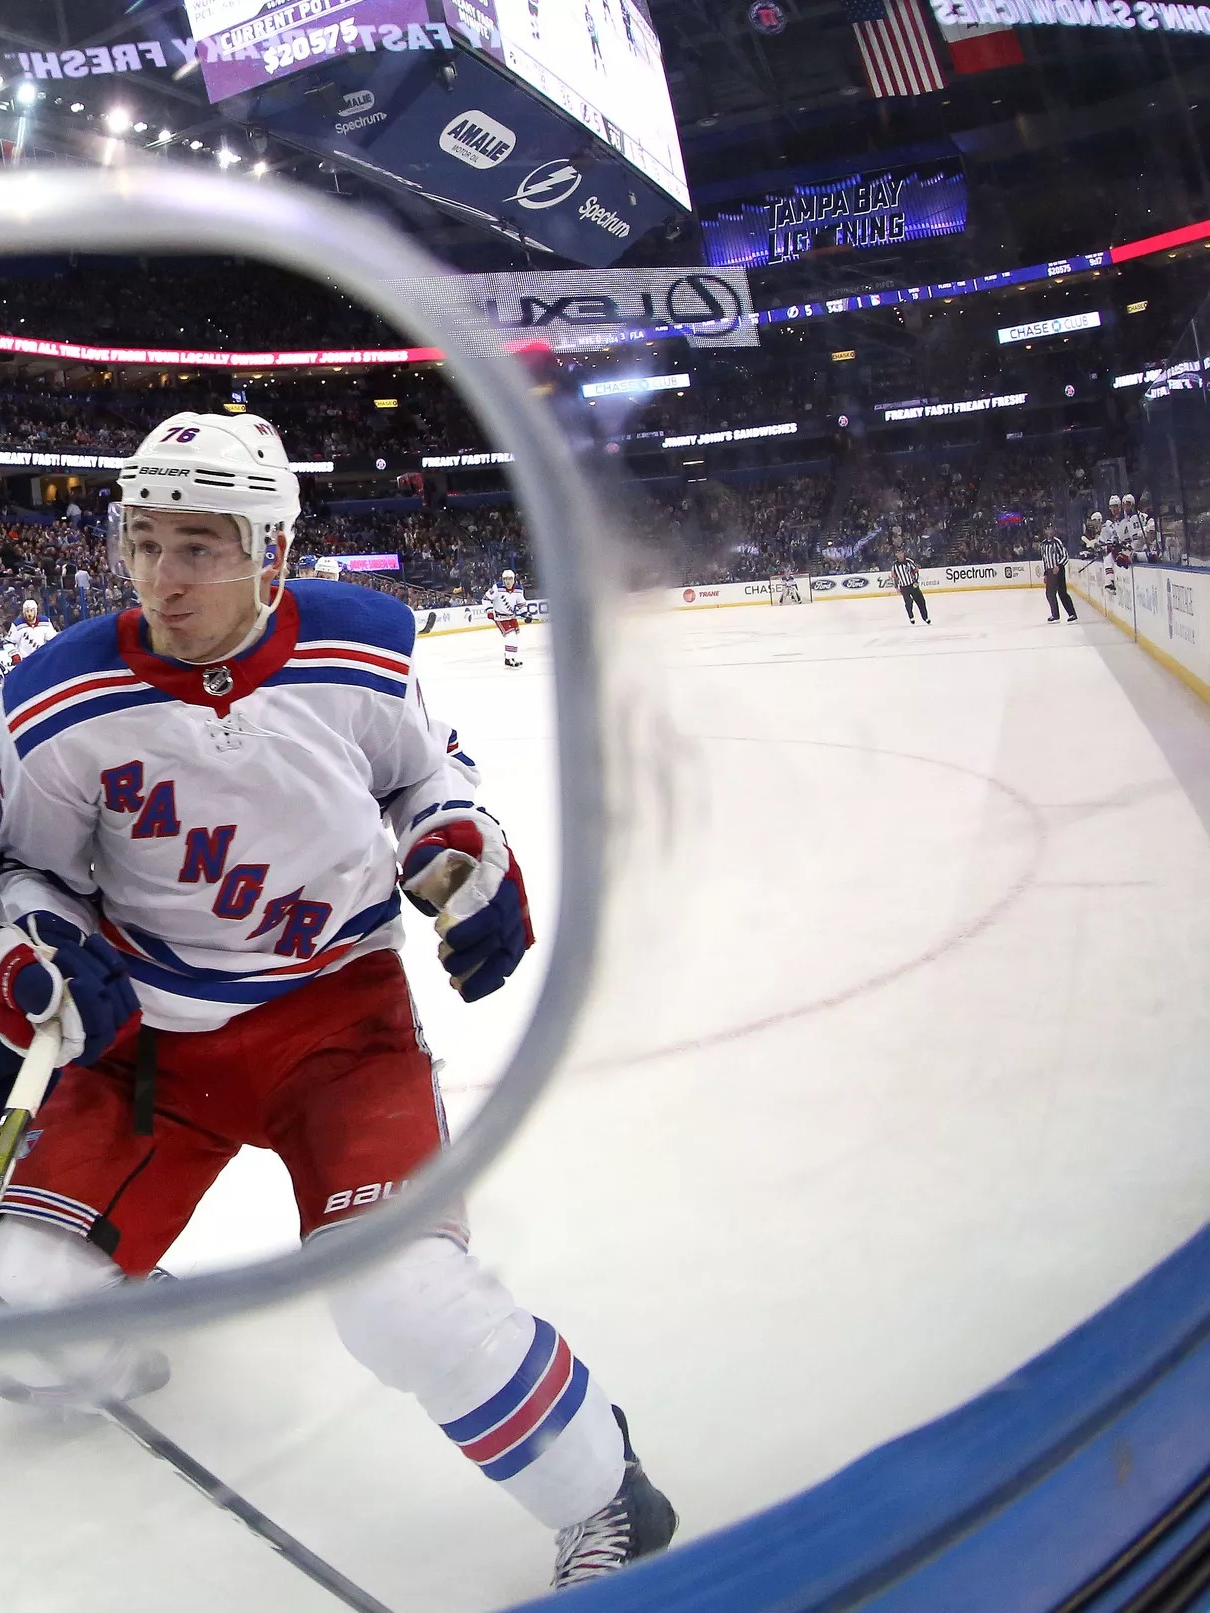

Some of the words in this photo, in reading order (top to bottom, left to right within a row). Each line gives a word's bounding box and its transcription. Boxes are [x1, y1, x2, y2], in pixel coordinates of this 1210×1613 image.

[220, 7, 299, 50] CURRENT
[299, 0, 332, 19] POT
[263, 17, 359, 75] $20575
[335, 111, 384, 136] Spectrum
[446, 118, 511, 163] AMALIE
[451, 143, 470, 159] MOTOR
[470, 153, 479, 164] OIL
[764, 190, 850, 231] TAMPA
[853, 180, 903, 216] BAY
[578, 195, 628, 238] Spectrum
[1047, 264, 1072, 276] $20575
[804, 304, 813, 317] 5
[629, 331, 645, 340] FLA
[1009, 322, 1050, 339] CHASE
[1063, 315, 1089, 331] CLUB
[15, 339, 38, 353] FOR
[38, 342, 59, 355] ALL
[59, 344, 80, 358] THE
[81, 347, 109, 361] LOVE
[110, 349, 146, 362] FROM
[147, 350, 179, 364] YOUR
[181, 351, 230, 366] LOCALLY
[230, 353, 274, 366] OWNED
[275, 352, 318, 366] JIMMY
[318, 351, 363, 364] JOHN'S
[363, 350, 408, 363] STORES
[594, 380, 636, 395] CHASE
[652, 376, 678, 389] CLUB
[884, 405, 922, 422] FREAKY
[924, 401, 954, 418] FAST!
[953, 397, 991, 414] FREAKY
[159, 426, 201, 444] 76
[662, 435, 697, 449] JIMMY
[697, 430, 732, 447] JOHN'S
[733, 423, 797, 443] SANDWICHES
[32, 452, 61, 467] FAST!
[60, 454, 98, 468] FREAKY
[422, 456, 460, 468] FREAKY
[461, 453, 490, 466] FAST!
[138, 465, 191, 478] BAUER
[946, 566, 995, 584] Spectrum
[699, 590, 720, 598] TRANE
[744, 583, 783, 596] CHASE
[324, 1177, 414, 1215] BAU
